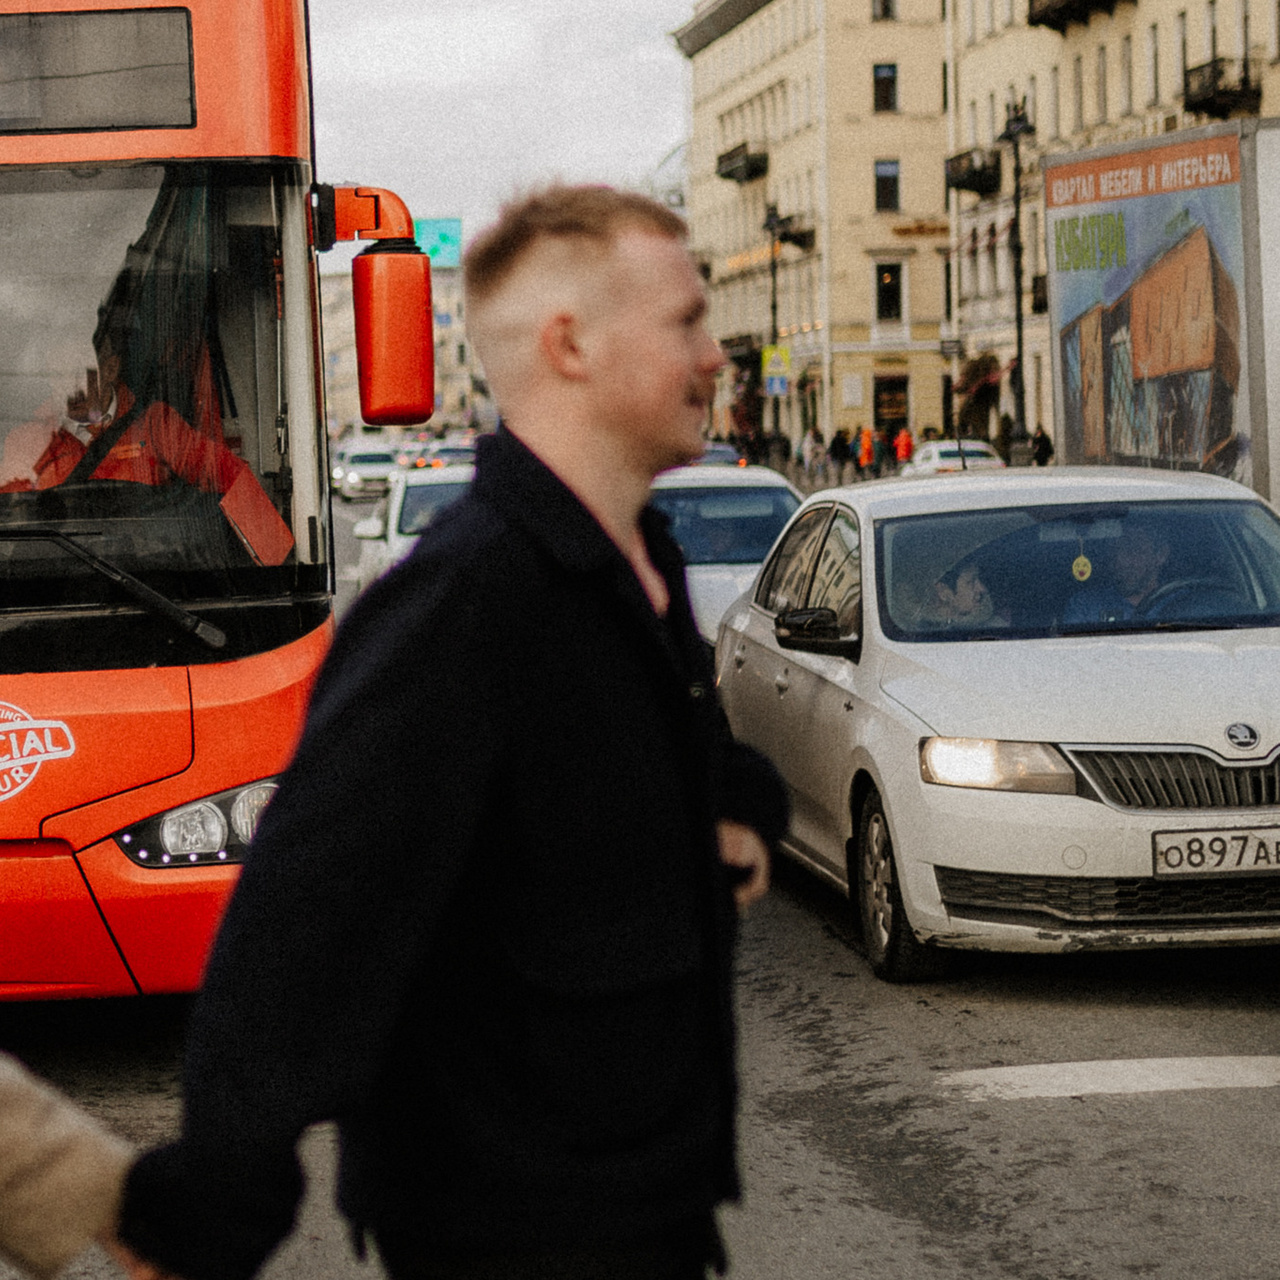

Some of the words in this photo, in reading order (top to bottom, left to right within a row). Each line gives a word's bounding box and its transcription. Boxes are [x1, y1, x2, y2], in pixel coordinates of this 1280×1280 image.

[1052, 174, 1096, 205] КВАРТАЛ
[1100, 165, 1143, 197] МЕБЕЛИ
[1147, 163, 1156, 191] И
[1161, 152, 1232, 189] ИНТЕРЬЕРА
[1054, 211, 1127, 271] КУБАТУРА
